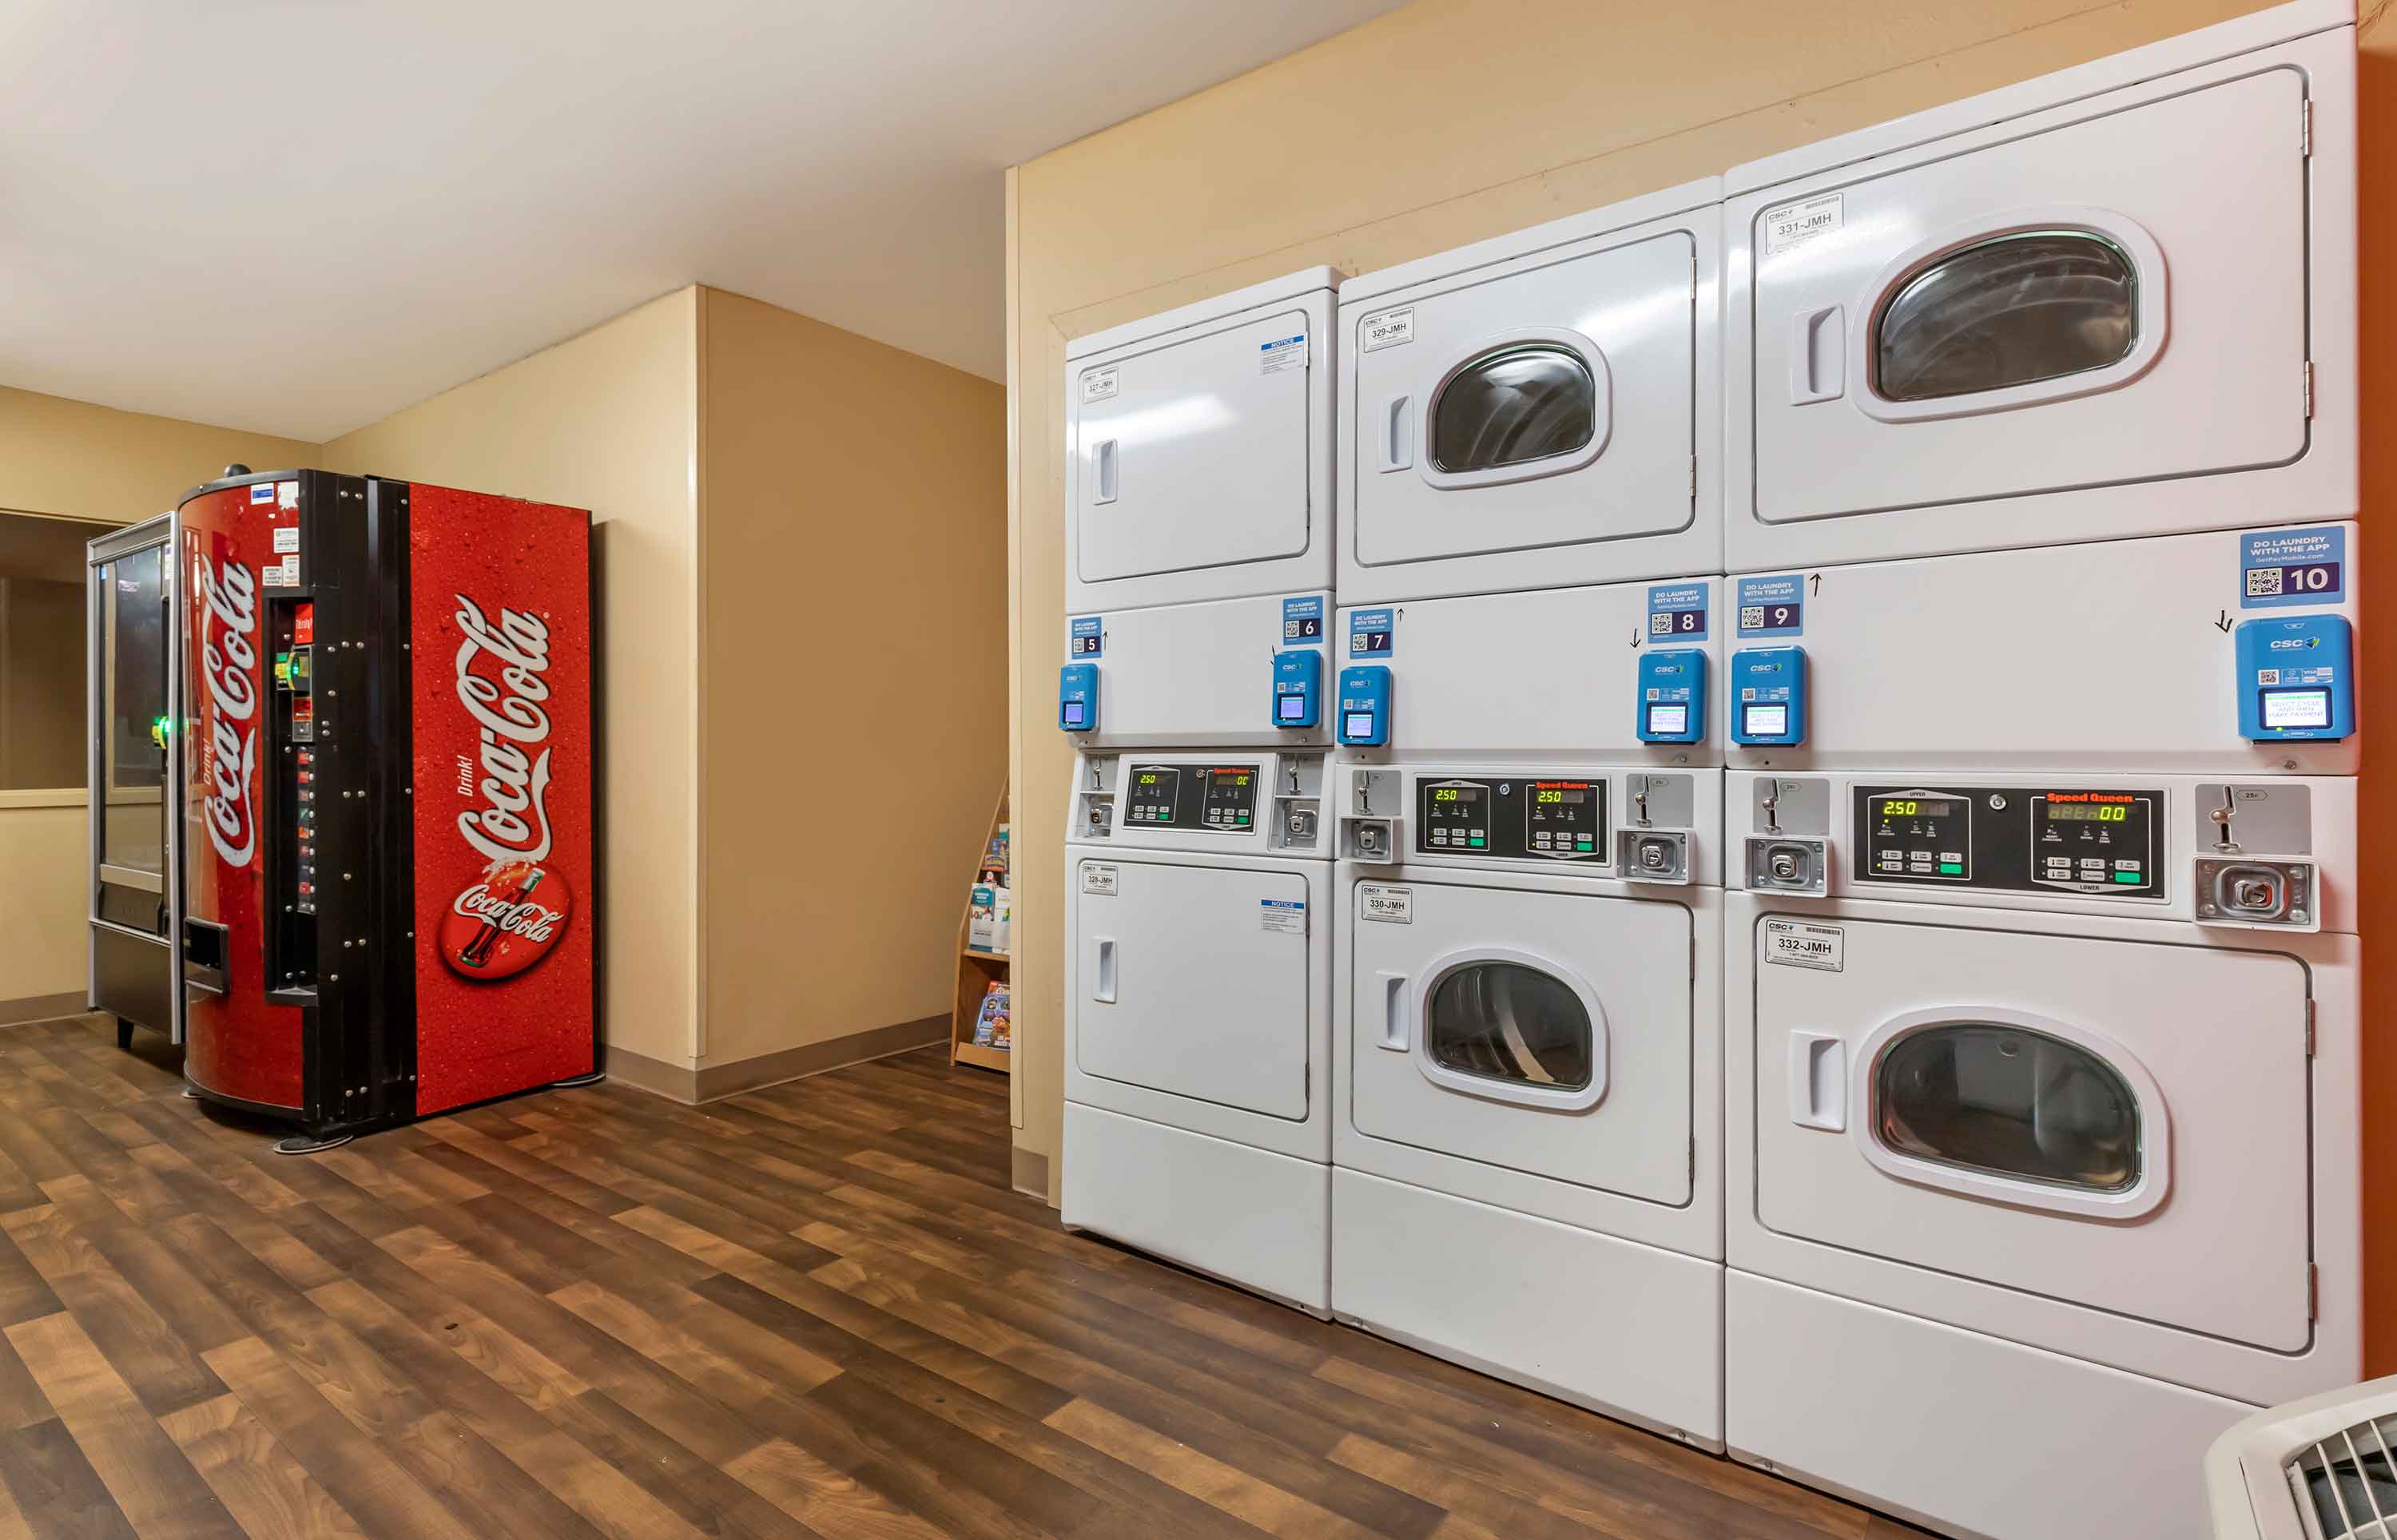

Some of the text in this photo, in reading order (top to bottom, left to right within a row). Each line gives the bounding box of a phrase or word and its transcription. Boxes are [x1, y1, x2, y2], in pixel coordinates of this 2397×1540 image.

[1779, 212, 1831, 235] 331-JMH
[1373, 323, 1406, 338] 329-JMH
[2272, 536, 2326, 547] LAUNDRY
[2250, 547, 2280, 556] WITH
[2281, 545, 2304, 554] THE
[2291, 568, 2328, 590] 10
[1682, 614, 1694, 630] 8
[1775, 608, 1788, 625] 9
[1306, 621, 1314, 634] 6
[1088, 639, 1095, 650] 5
[1374, 634, 1383, 649] 7
[2270, 639, 2304, 649] CSC
[202, 553, 256, 867] Coca-Cola
[455, 593, 552, 863] Coca-Cola
[457, 754, 474, 797] Drink!
[1436, 789, 1457, 800] 2.50
[1538, 792, 1561, 802] 2.50
[2047, 792, 2134, 803] Speed Queen
[1883, 801, 1917, 815] 2.50
[1370, 899, 1405, 910] 330-JMH
[454, 883, 564, 943] Coca-Cola
[1779, 939, 1831, 954] 332-JMH
